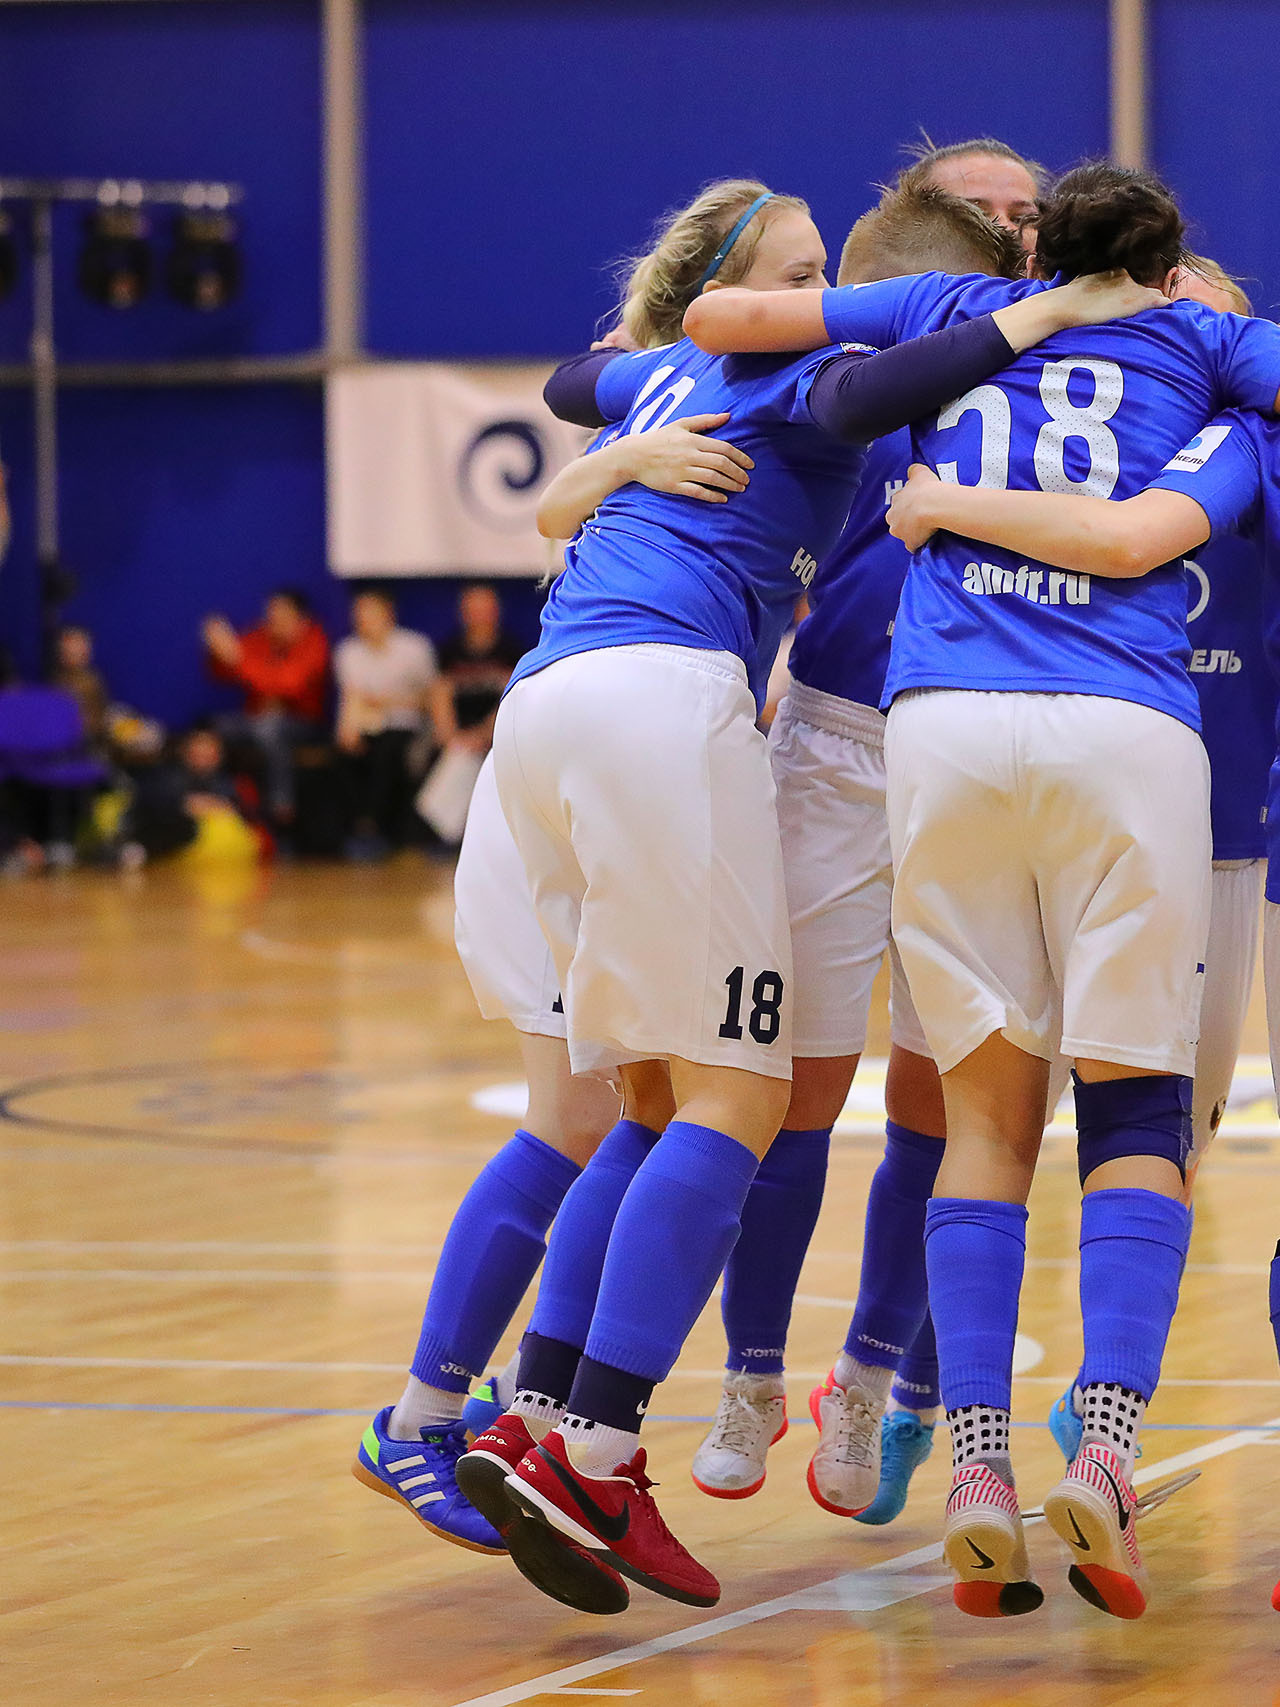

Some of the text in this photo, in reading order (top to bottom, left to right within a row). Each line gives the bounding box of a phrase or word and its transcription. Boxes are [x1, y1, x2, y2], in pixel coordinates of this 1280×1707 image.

[962, 562, 1090, 605] amfr.ru
[1188, 649, 1242, 674] ЕЛЬ
[718, 966, 784, 1045] 18
[858, 1334, 904, 1355] Joma
